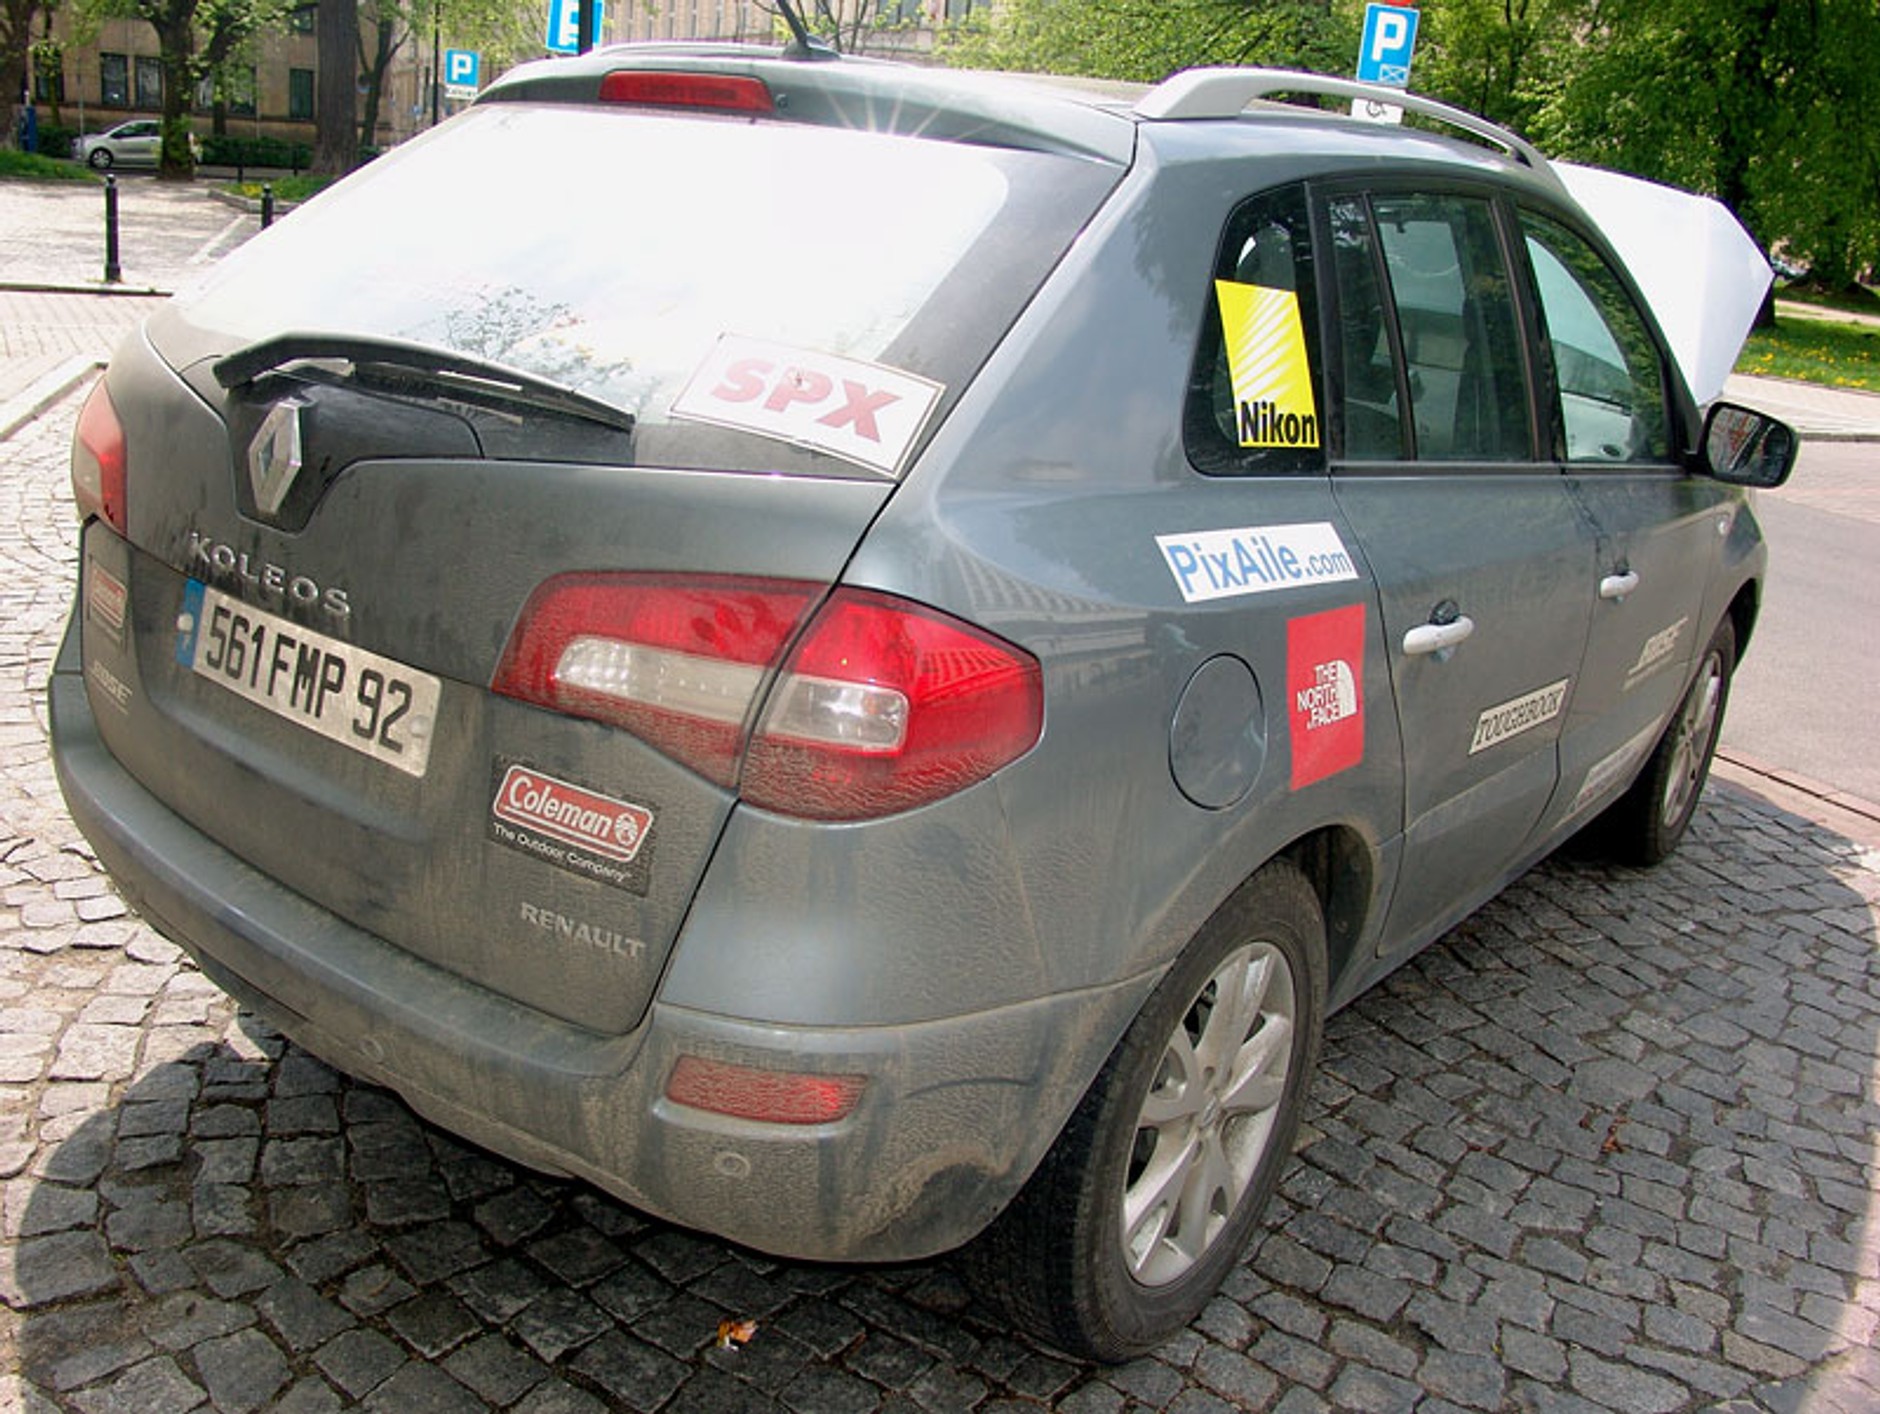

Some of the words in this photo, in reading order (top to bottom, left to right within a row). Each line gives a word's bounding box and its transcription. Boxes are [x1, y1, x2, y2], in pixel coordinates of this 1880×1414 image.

[1372, 11, 1407, 61] P
[451, 54, 472, 81] P
[710, 358, 902, 443] SPX
[1240, 401, 1315, 444] Nikon
[189, 532, 350, 616] KOLEOS
[1166, 536, 1351, 593] PixAile.com
[206, 605, 265, 688] 561
[268, 633, 345, 719] FMP
[353, 669, 412, 754] 92
[1314, 660, 1338, 684] THE
[1297, 684, 1337, 713] NORTH
[1307, 703, 1340, 730] FACE
[509, 776, 613, 838] Coleman
[494, 822, 515, 840] The
[517, 833, 566, 860] Outdoor
[520, 902, 646, 957] RENAULT
